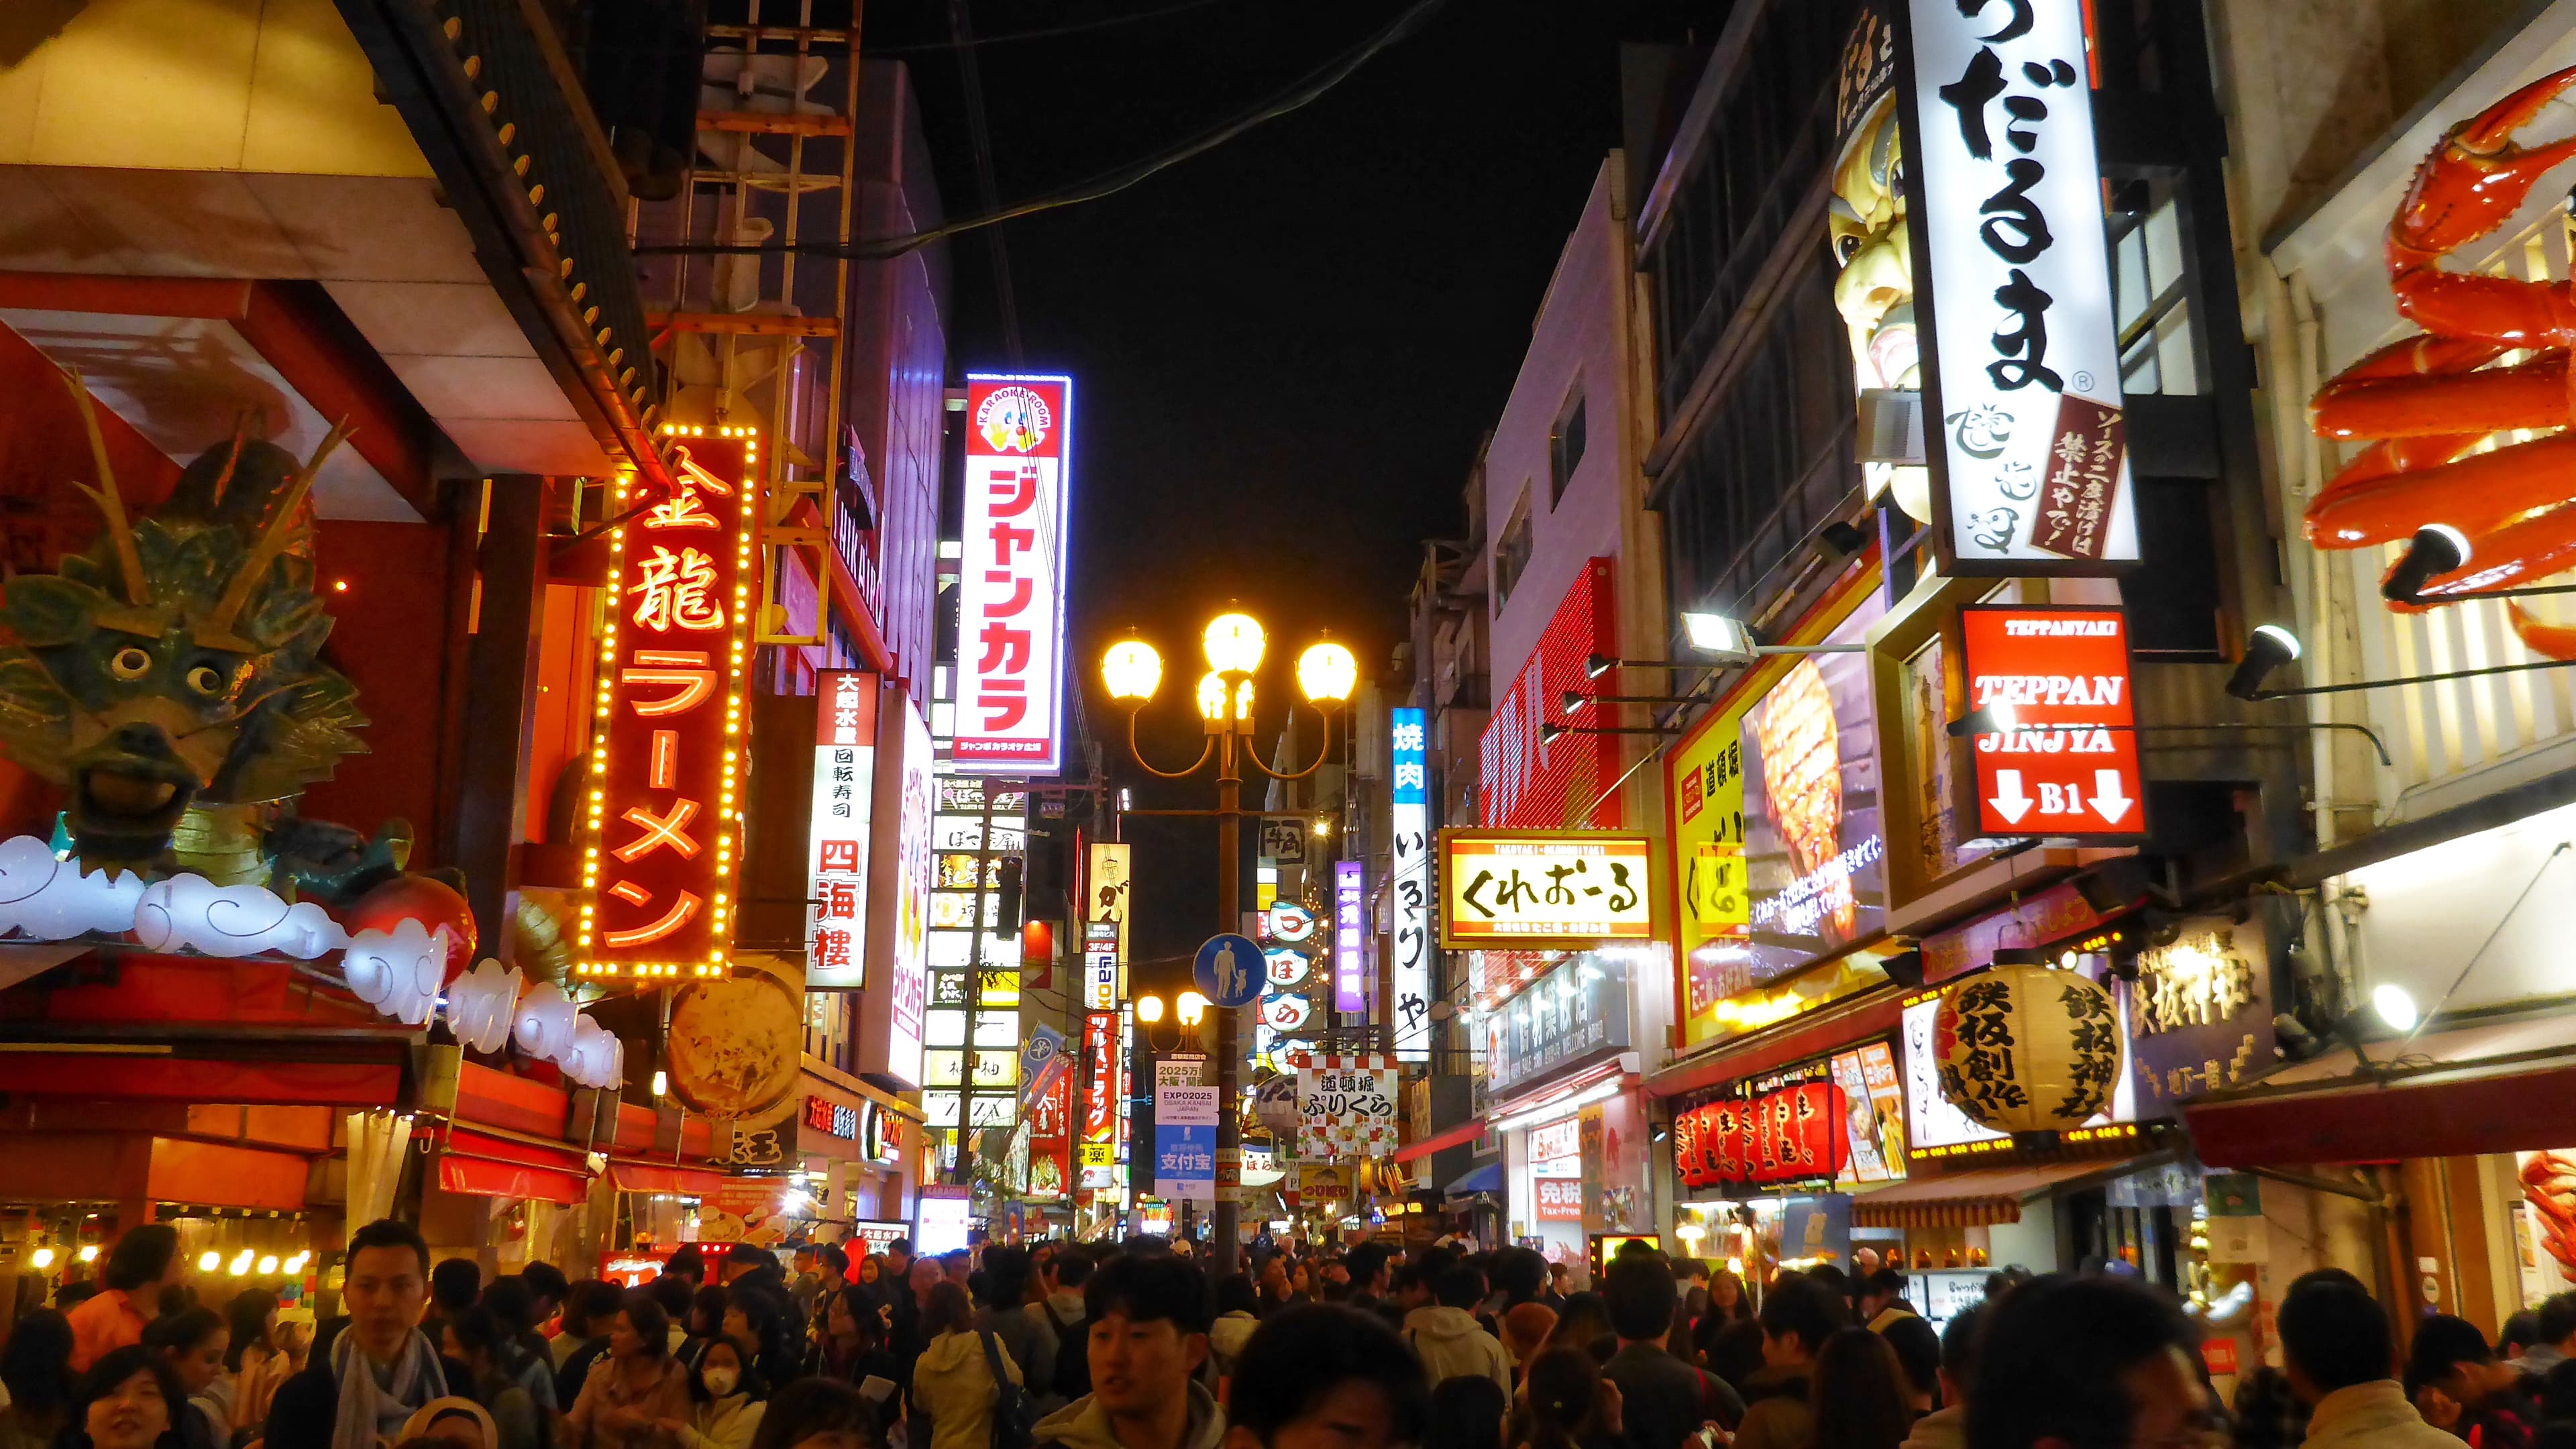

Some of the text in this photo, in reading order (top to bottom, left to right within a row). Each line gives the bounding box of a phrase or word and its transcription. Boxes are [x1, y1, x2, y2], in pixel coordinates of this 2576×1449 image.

[979, 389, 1049, 426] KARAOKE ROOM
[978, 466, 1037, 732] ジャンカラ
[2005, 620, 2117, 636] TEPPANYAKI
[603, 445, 735, 948] 金龍ラーメン
[1974, 676, 2123, 705] TEPPAN
[835, 674, 860, 745] 大起水産
[1979, 723, 2116, 753] JINJYA
[1393, 723, 1424, 790] 焼肉
[833, 749, 854, 818] 回転寿司
[2037, 782, 2084, 814] B1
[1463, 859, 1637, 918] くれおーる
[1088, 943, 1115, 951] 3F/4F
[894, 956, 922, 1019] ジャンカラ
[1955, 981, 2028, 1111] 鉄板創作
[2052, 984, 2116, 1118] 鉄板神社
[1163, 1091, 1212, 1099] EXPO2025
[1320, 1075, 1375, 1092] 道頓堀
[1303, 1093, 1393, 1118] ぷりくら
[1089, 1147, 1105, 1163] 薬
[1161, 1153, 1212, 1171] 支付宝
[1540, 1181, 1582, 1203] 免税
